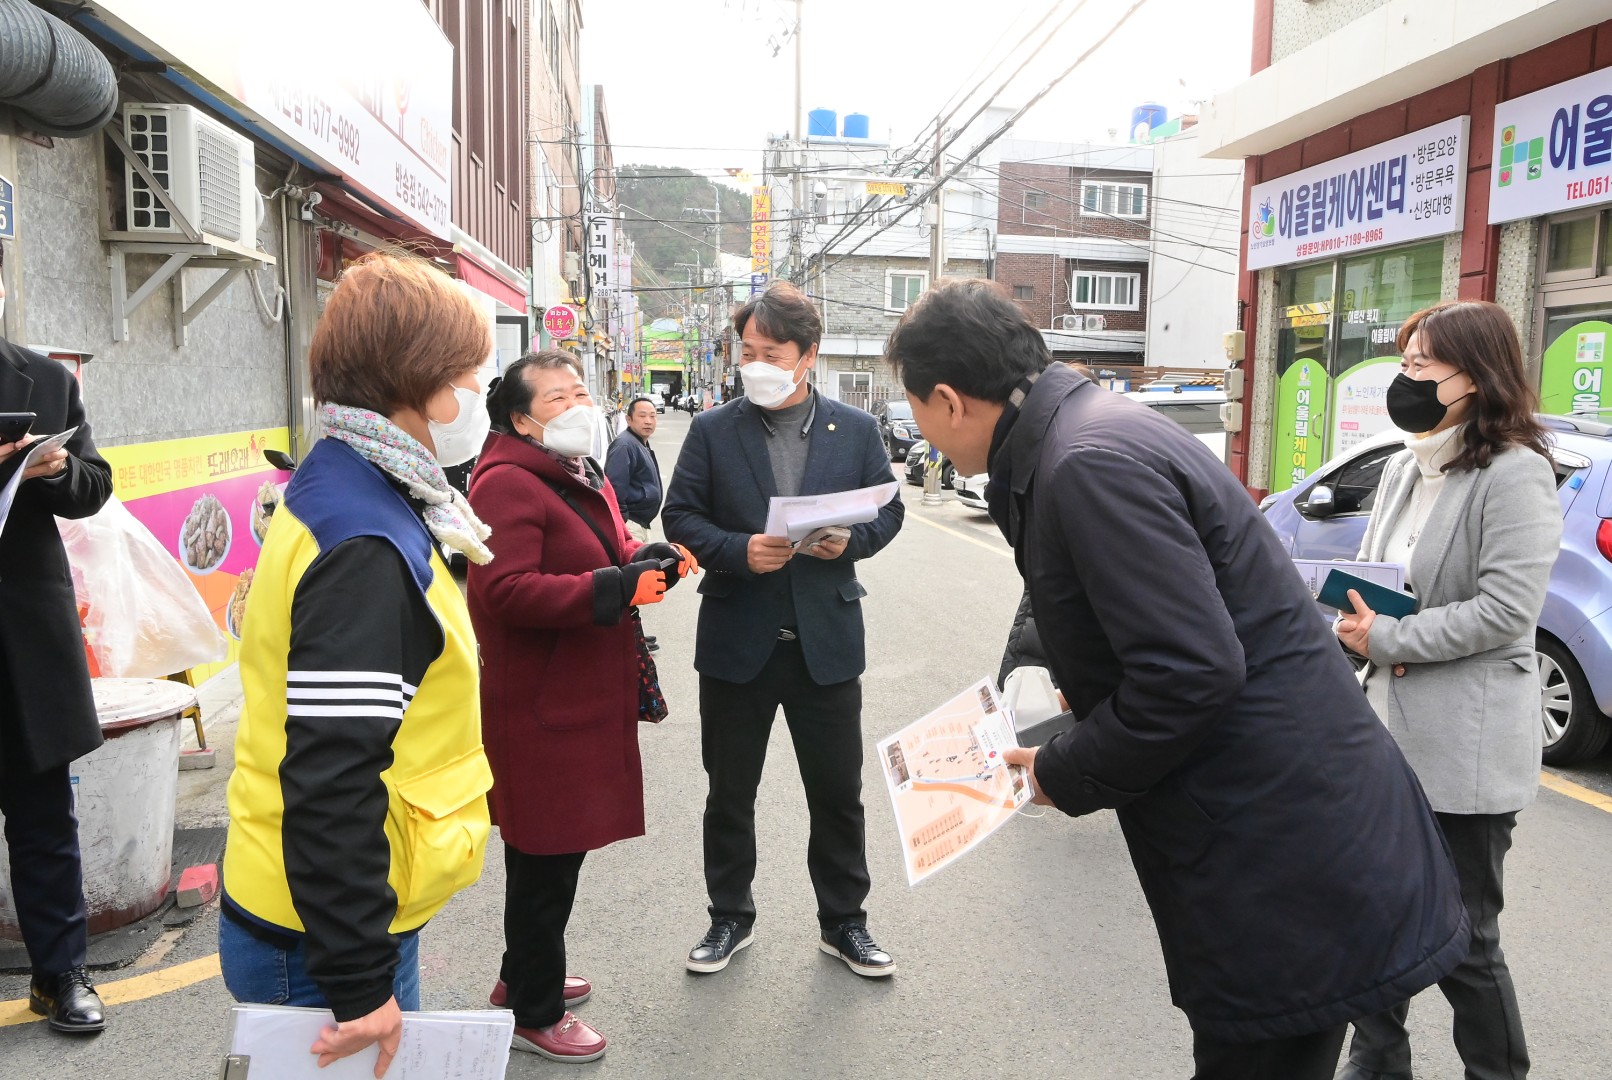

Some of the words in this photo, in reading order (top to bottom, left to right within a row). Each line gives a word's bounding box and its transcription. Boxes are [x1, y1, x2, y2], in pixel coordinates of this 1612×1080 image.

[307, 94, 360, 166] 1577-9992
[1416, 135, 1457, 165] 방문요양
[1414, 165, 1455, 193] 방문목욕
[395, 161, 416, 209] 반송점
[417, 181, 447, 228] 542-3737
[1279, 155, 1407, 239] 어울림케어센터
[1413, 194, 1453, 220] 신청대행
[1348, 311, 1365, 324] 어르신
[139, 460, 172, 485] 대한민국
